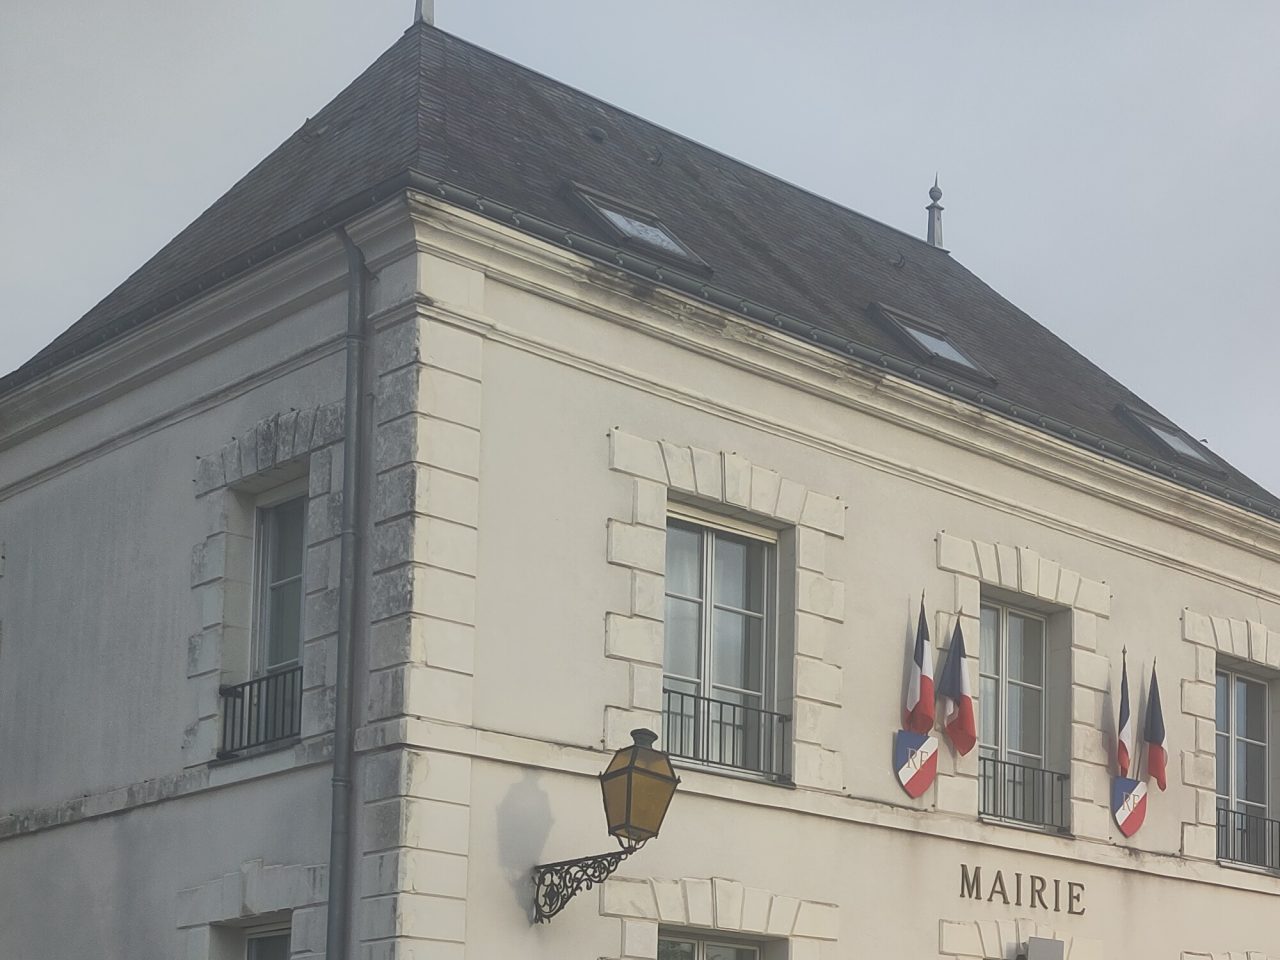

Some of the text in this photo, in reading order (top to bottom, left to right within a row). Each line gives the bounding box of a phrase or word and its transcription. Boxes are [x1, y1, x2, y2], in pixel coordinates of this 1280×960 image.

[905, 747, 929, 770] RF
[1121, 791, 1140, 811] RF
[960, 863, 1086, 915] MAIRIE
